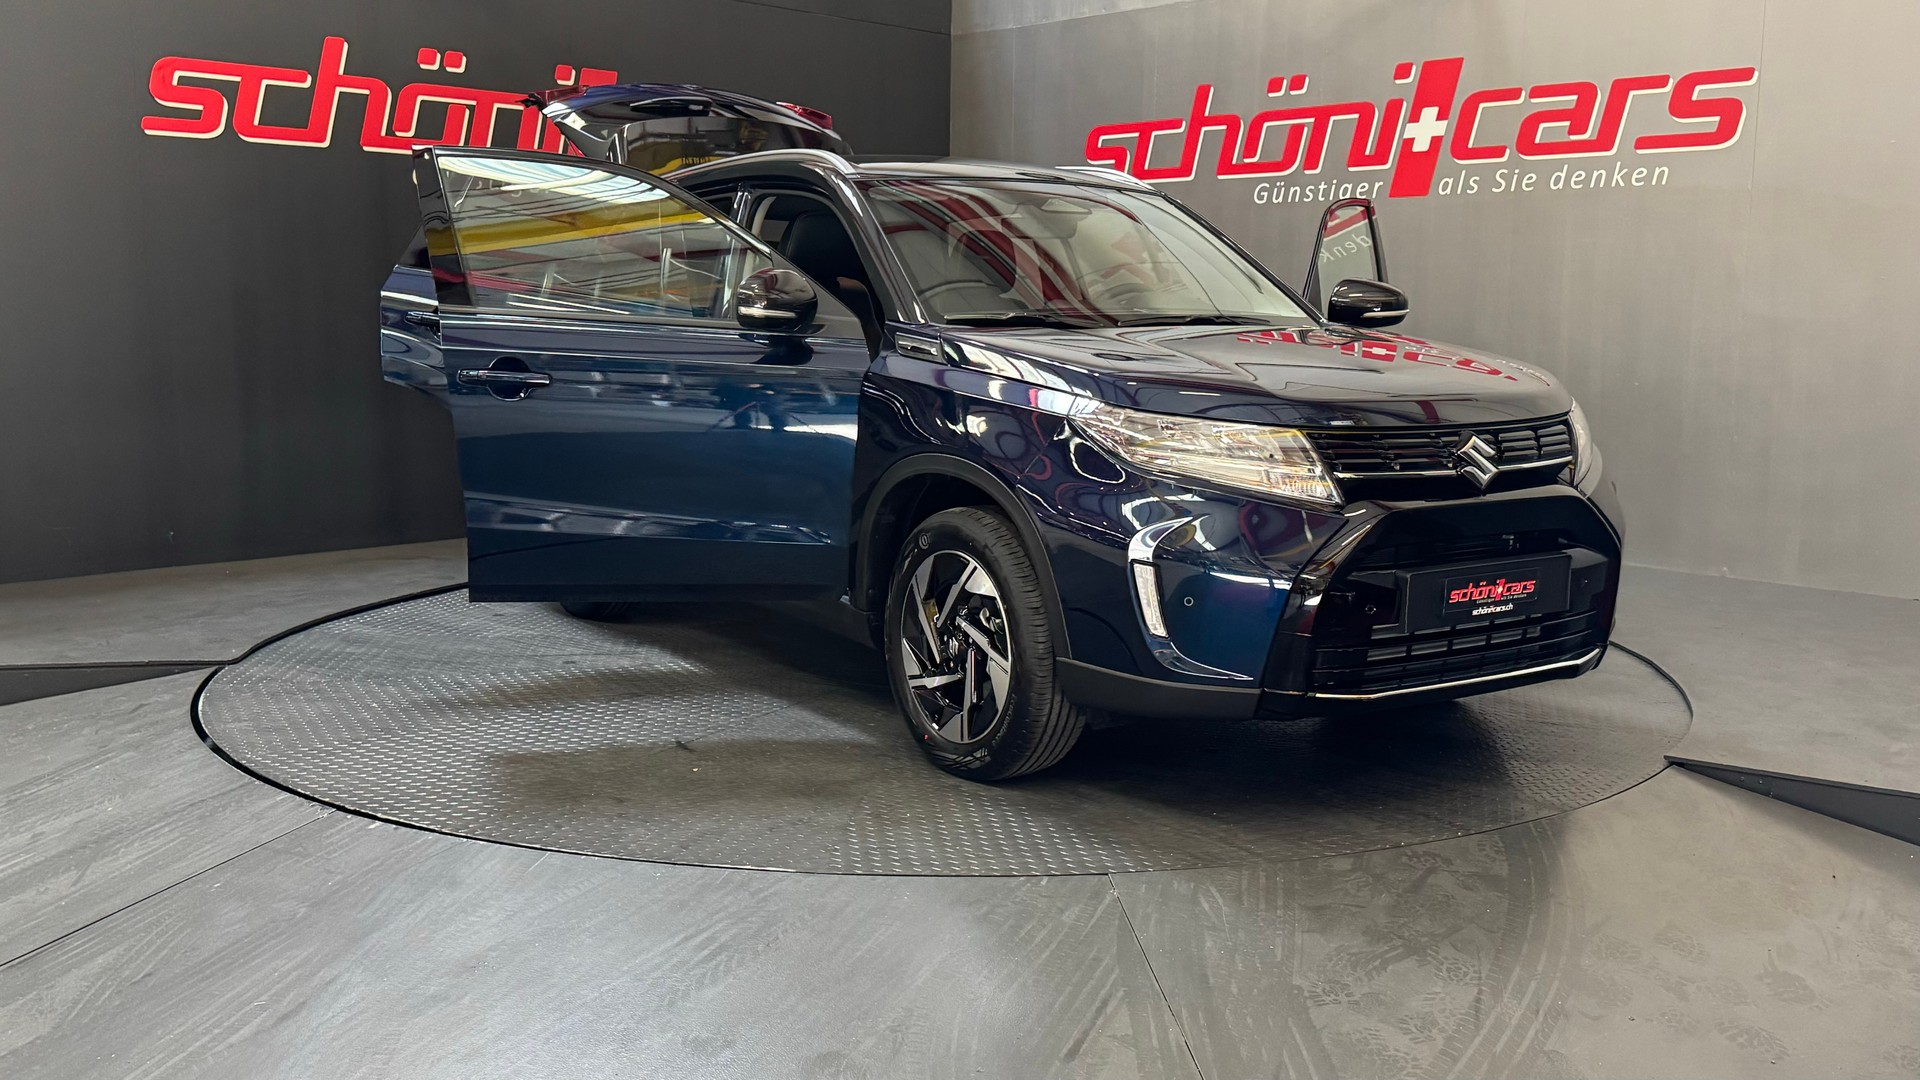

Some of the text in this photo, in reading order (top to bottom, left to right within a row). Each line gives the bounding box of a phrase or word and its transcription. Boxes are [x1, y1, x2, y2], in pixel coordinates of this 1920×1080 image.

[1437, 170, 1480, 196] als
[1491, 168, 1537, 193] Sie
[1549, 161, 1670, 190] denken
